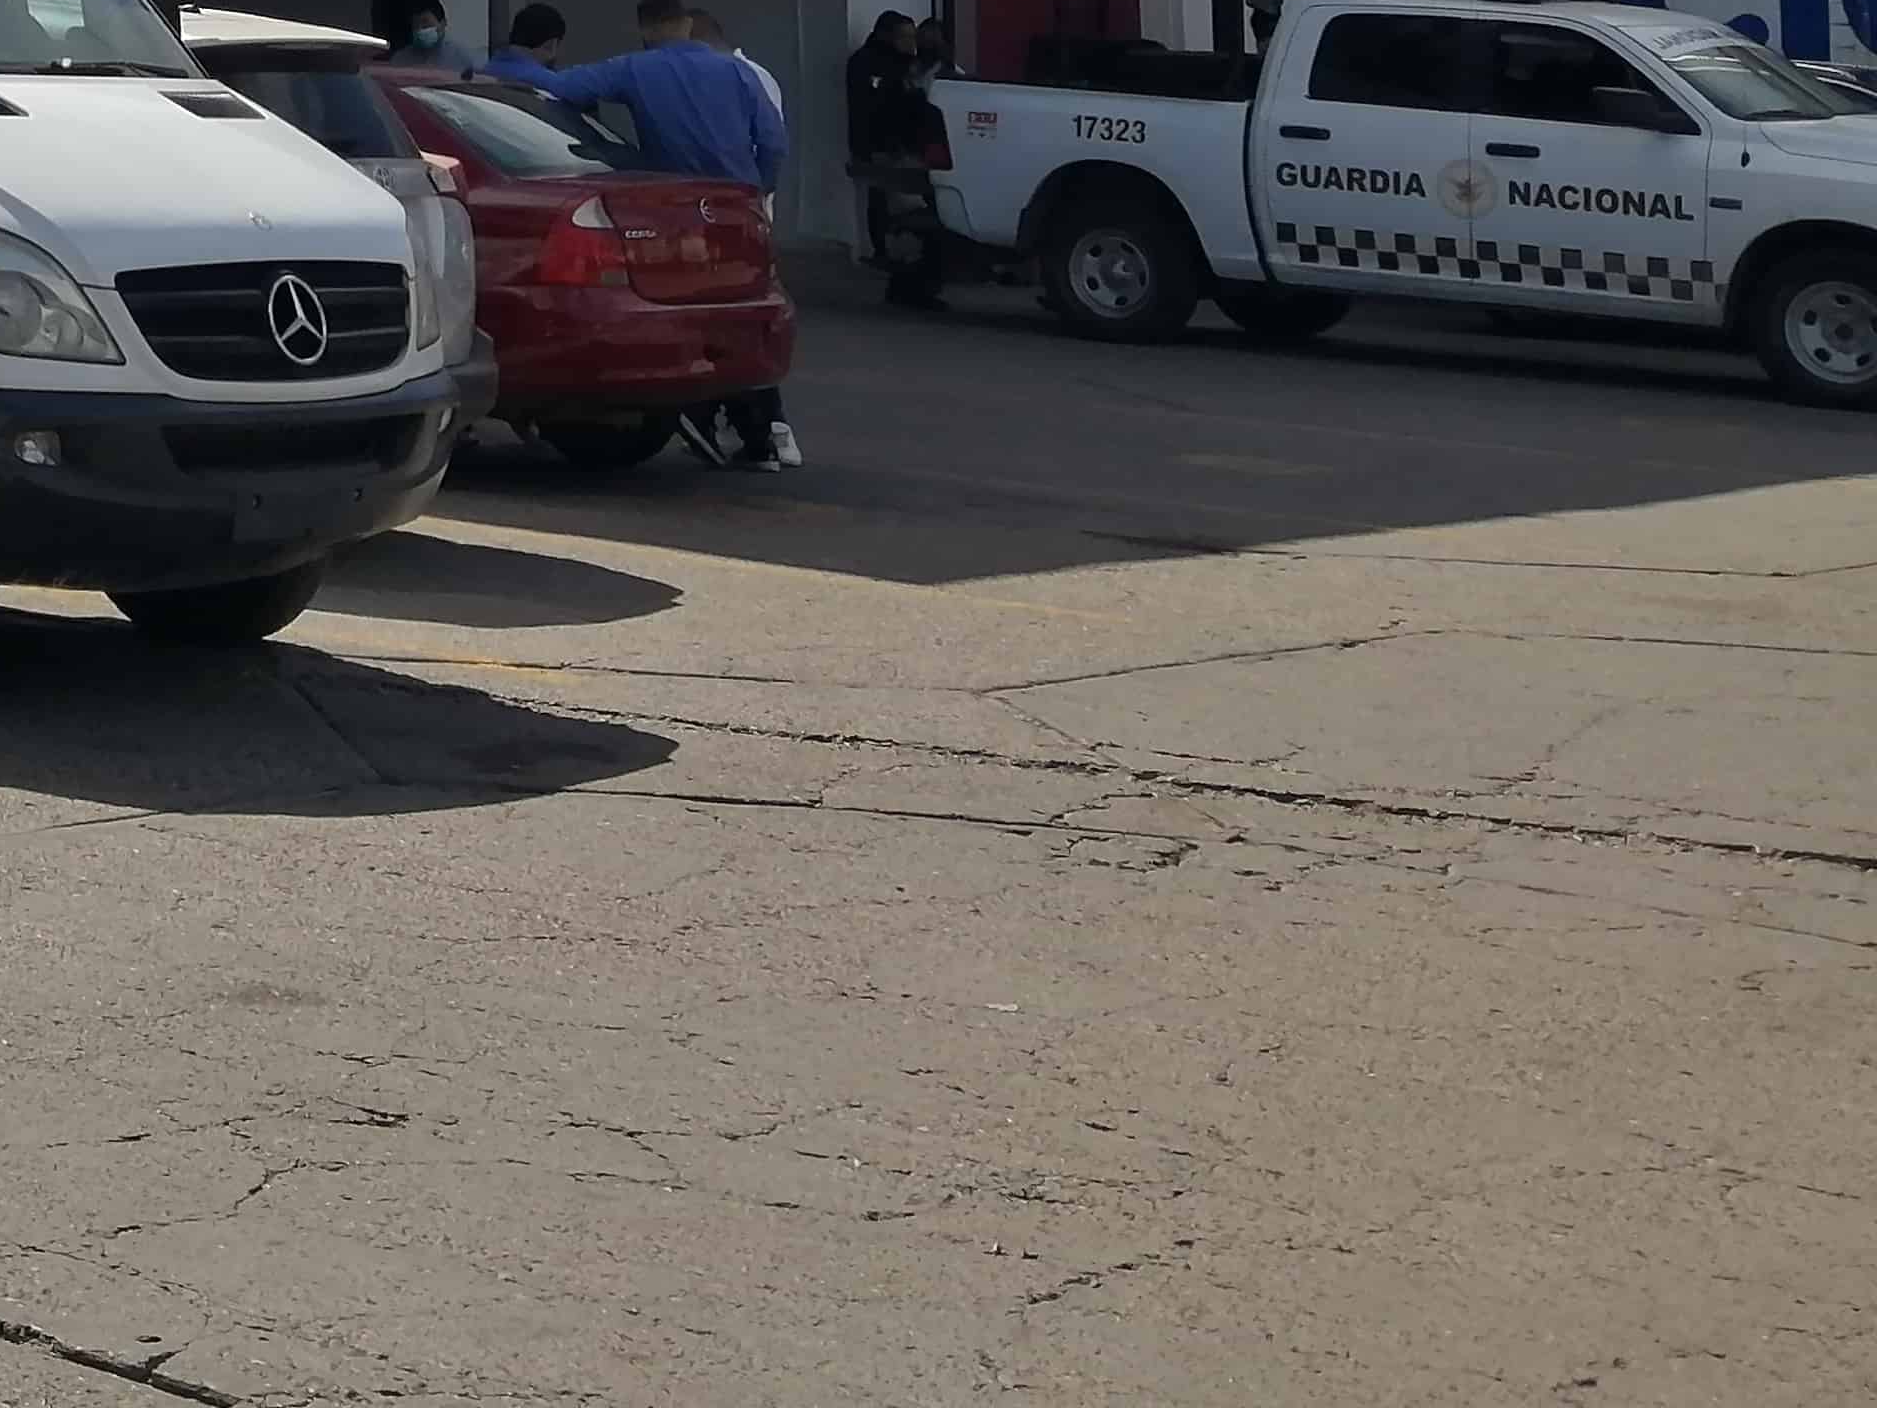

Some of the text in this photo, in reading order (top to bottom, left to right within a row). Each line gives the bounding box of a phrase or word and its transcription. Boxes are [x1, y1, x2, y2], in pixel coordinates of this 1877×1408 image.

[1072, 114, 1147, 144] 17323
[1275, 162, 1695, 222] GUARDIA NACIONAL
